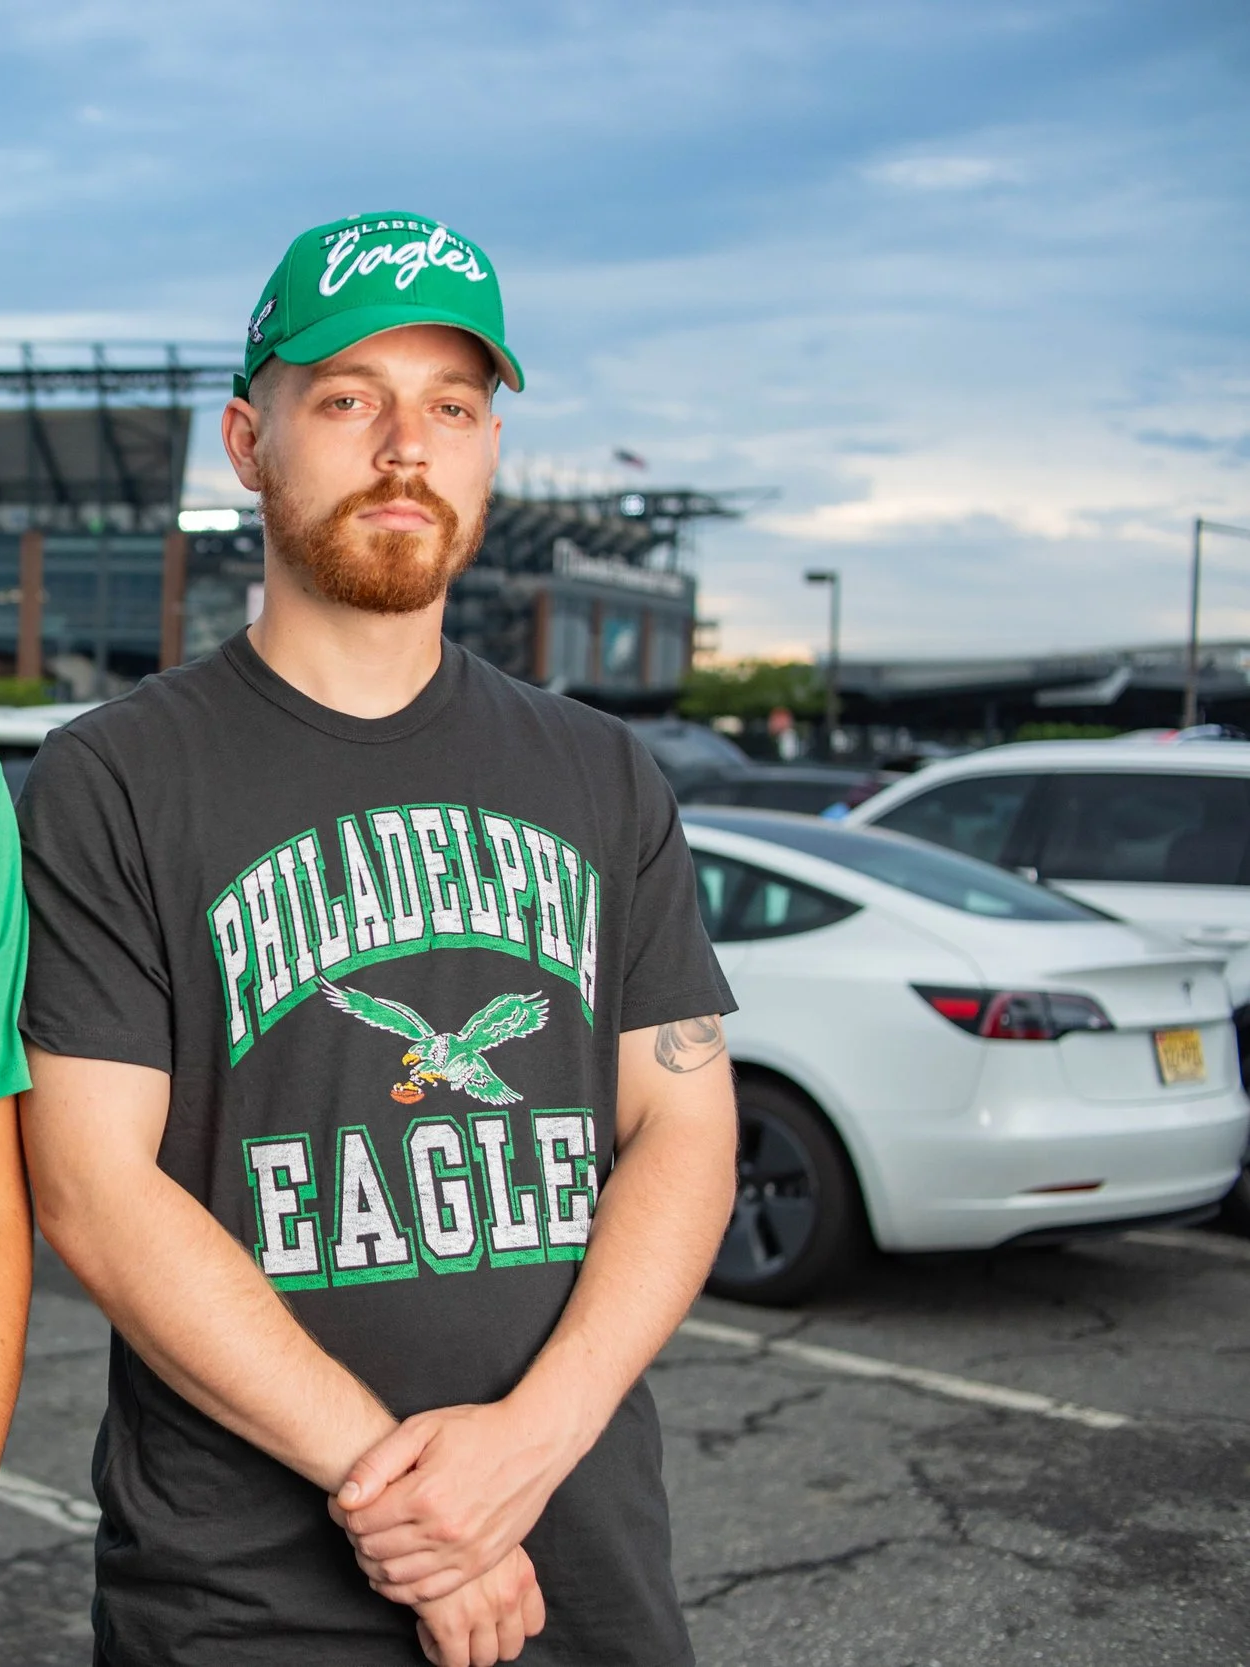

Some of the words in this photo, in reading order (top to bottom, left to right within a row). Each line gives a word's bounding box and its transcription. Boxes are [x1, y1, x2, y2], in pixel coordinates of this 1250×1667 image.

[318, 226, 488, 297] Eagles
[324, 220, 475, 255] PHILADELHIA
[207, 802, 600, 1070] PHILADELPHIA
